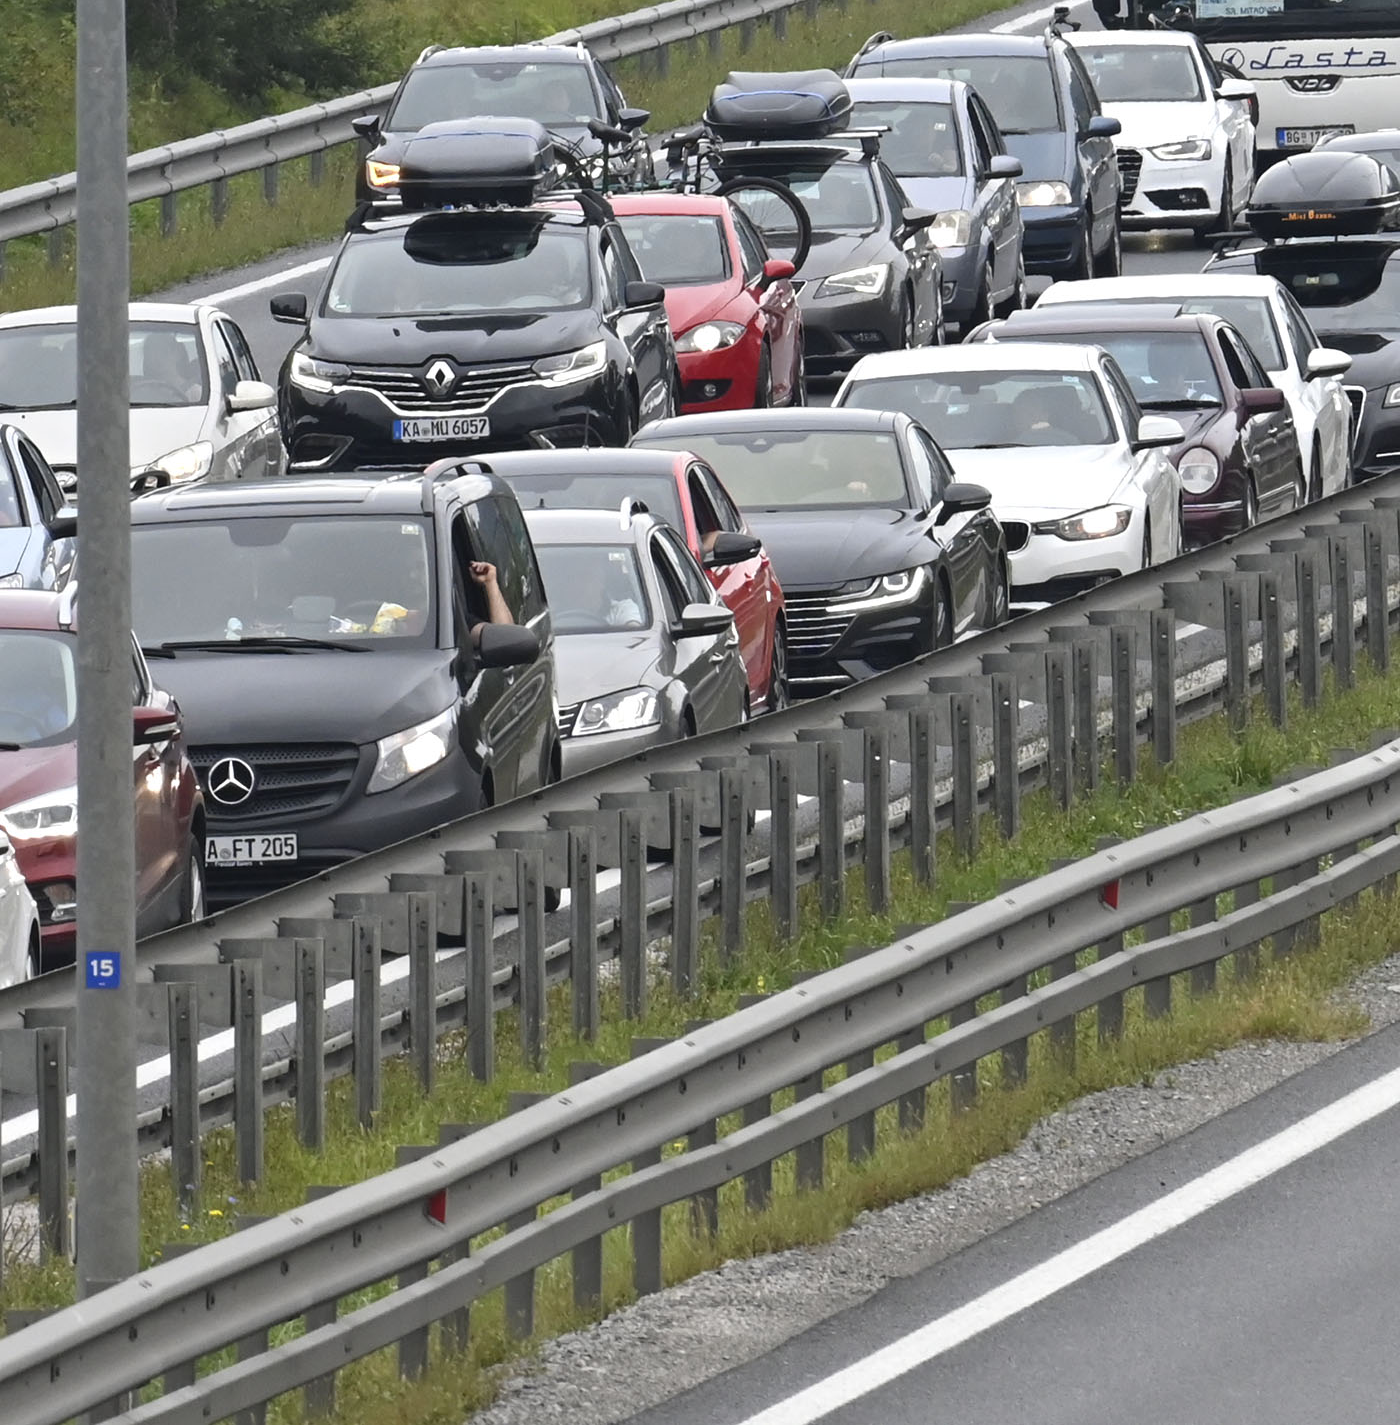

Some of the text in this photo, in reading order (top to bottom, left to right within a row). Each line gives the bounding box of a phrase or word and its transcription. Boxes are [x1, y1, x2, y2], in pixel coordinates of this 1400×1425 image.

[1250, 47, 1397, 70] Lasta
[1293, 78, 1332, 89] VDL
[402, 422, 420, 437] KA
[452, 418, 487, 435] 6057
[232, 838, 255, 858] FT
[261, 836, 295, 857] 205
[90, 959, 114, 977] 15
